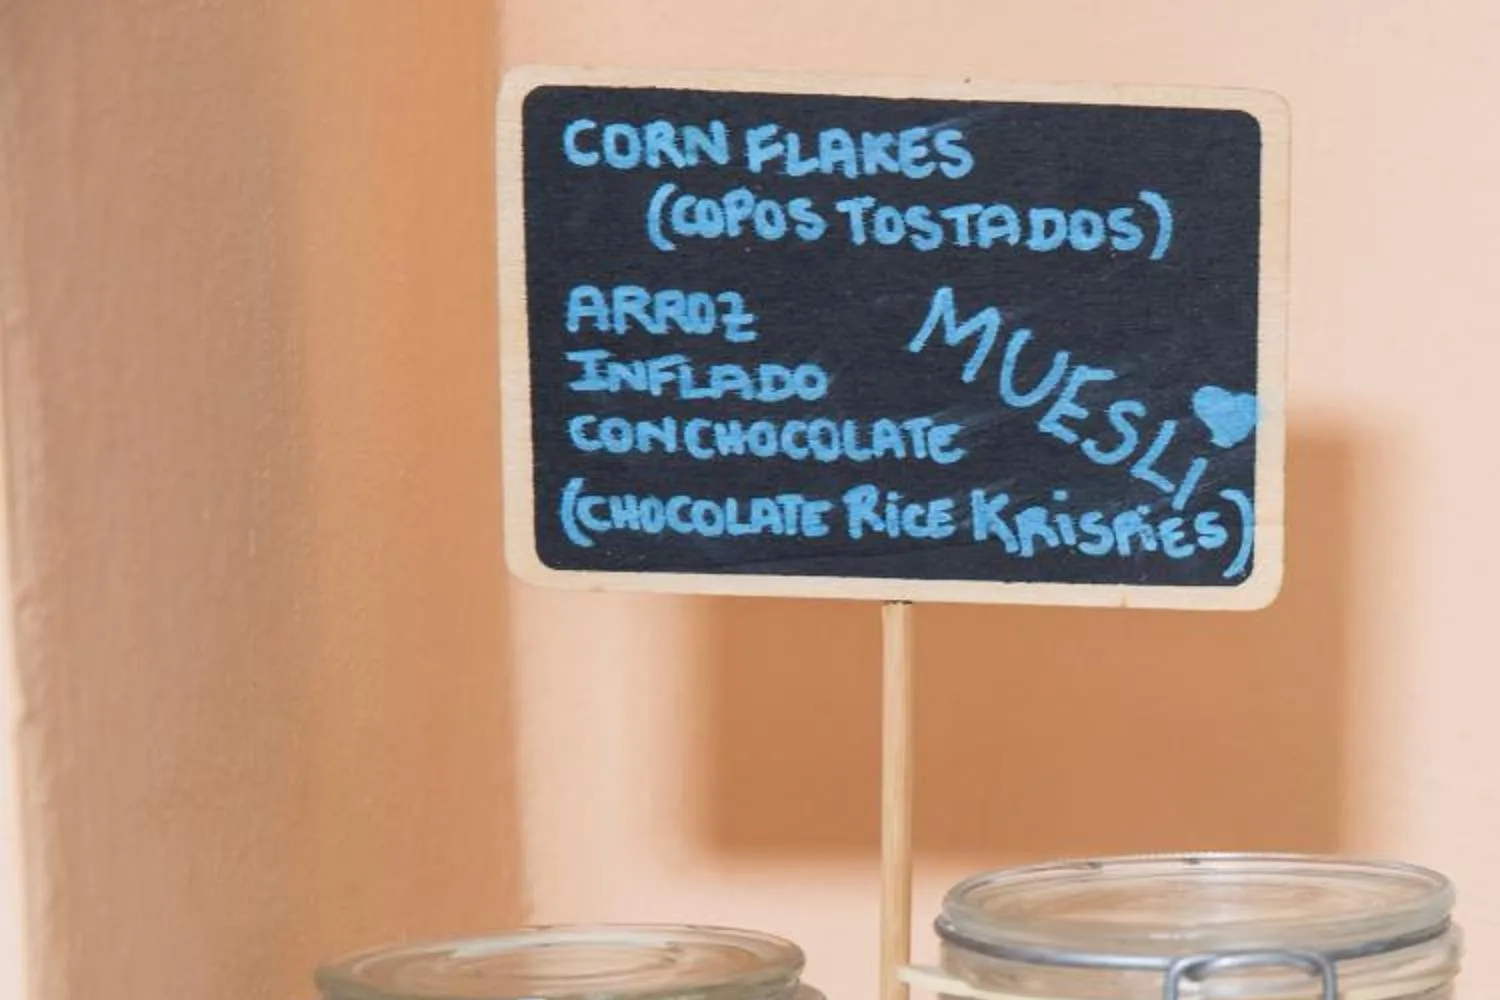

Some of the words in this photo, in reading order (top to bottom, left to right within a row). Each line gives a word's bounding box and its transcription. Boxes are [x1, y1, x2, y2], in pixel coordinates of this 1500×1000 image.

[563, 119, 730, 170] CORN
[744, 123, 975, 179] FLAKES
[647, 183, 830, 251] (COPOS
[836, 190, 1174, 260] TOSTADOS)
[565, 284, 759, 343] ARROZ
[564, 348, 832, 402] INFLADO
[908, 286, 1208, 511] MUESLI
[560, 477, 834, 548] (CHOCOLATE
